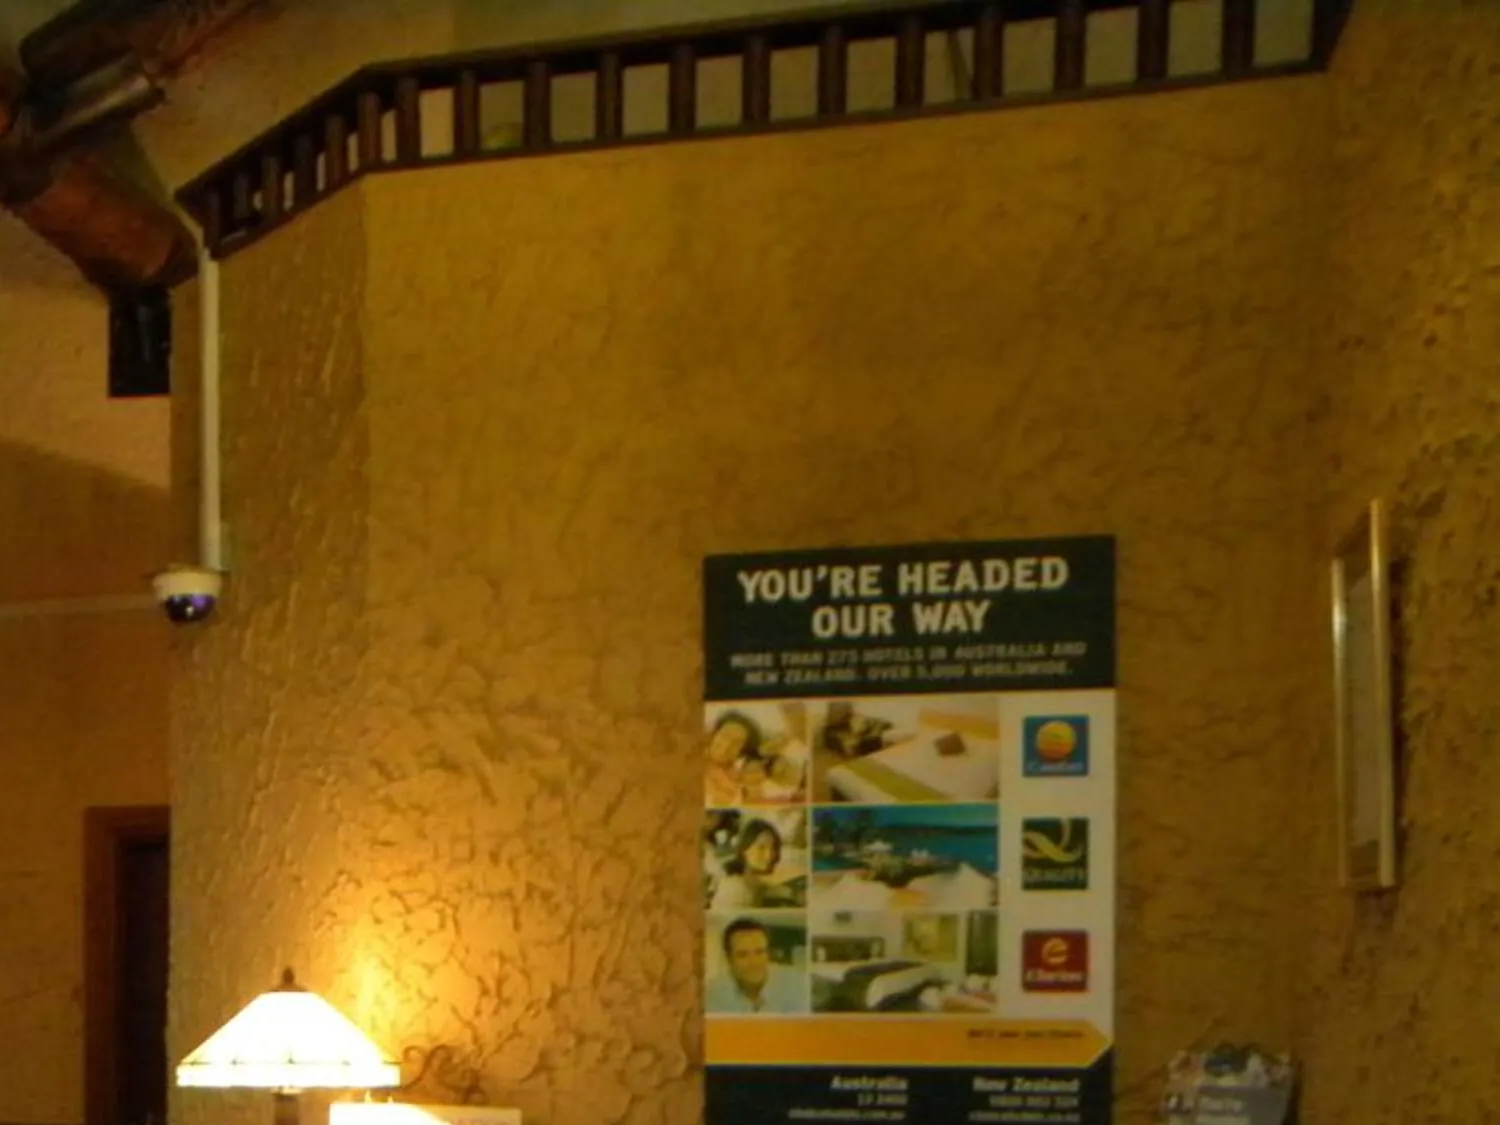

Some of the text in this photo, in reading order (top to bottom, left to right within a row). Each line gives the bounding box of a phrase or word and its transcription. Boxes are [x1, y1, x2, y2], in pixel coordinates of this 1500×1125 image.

[737, 557, 1069, 603] YOU'RE HEADED
[812, 600, 991, 638] OUR WAY
[731, 652, 773, 668] MORE
[781, 651, 823, 666] THAN
[863, 646, 924, 663] HOTELS
[929, 646, 947, 660] IN
[955, 643, 1045, 660] AUSTRALIA
[1052, 640, 1087, 656] AND
[745, 670, 779, 685] NEW
[867, 665, 911, 681] OVER
[830, 1075, 909, 1091] Australia
[972, 1076, 1080, 1093] New Zealand
